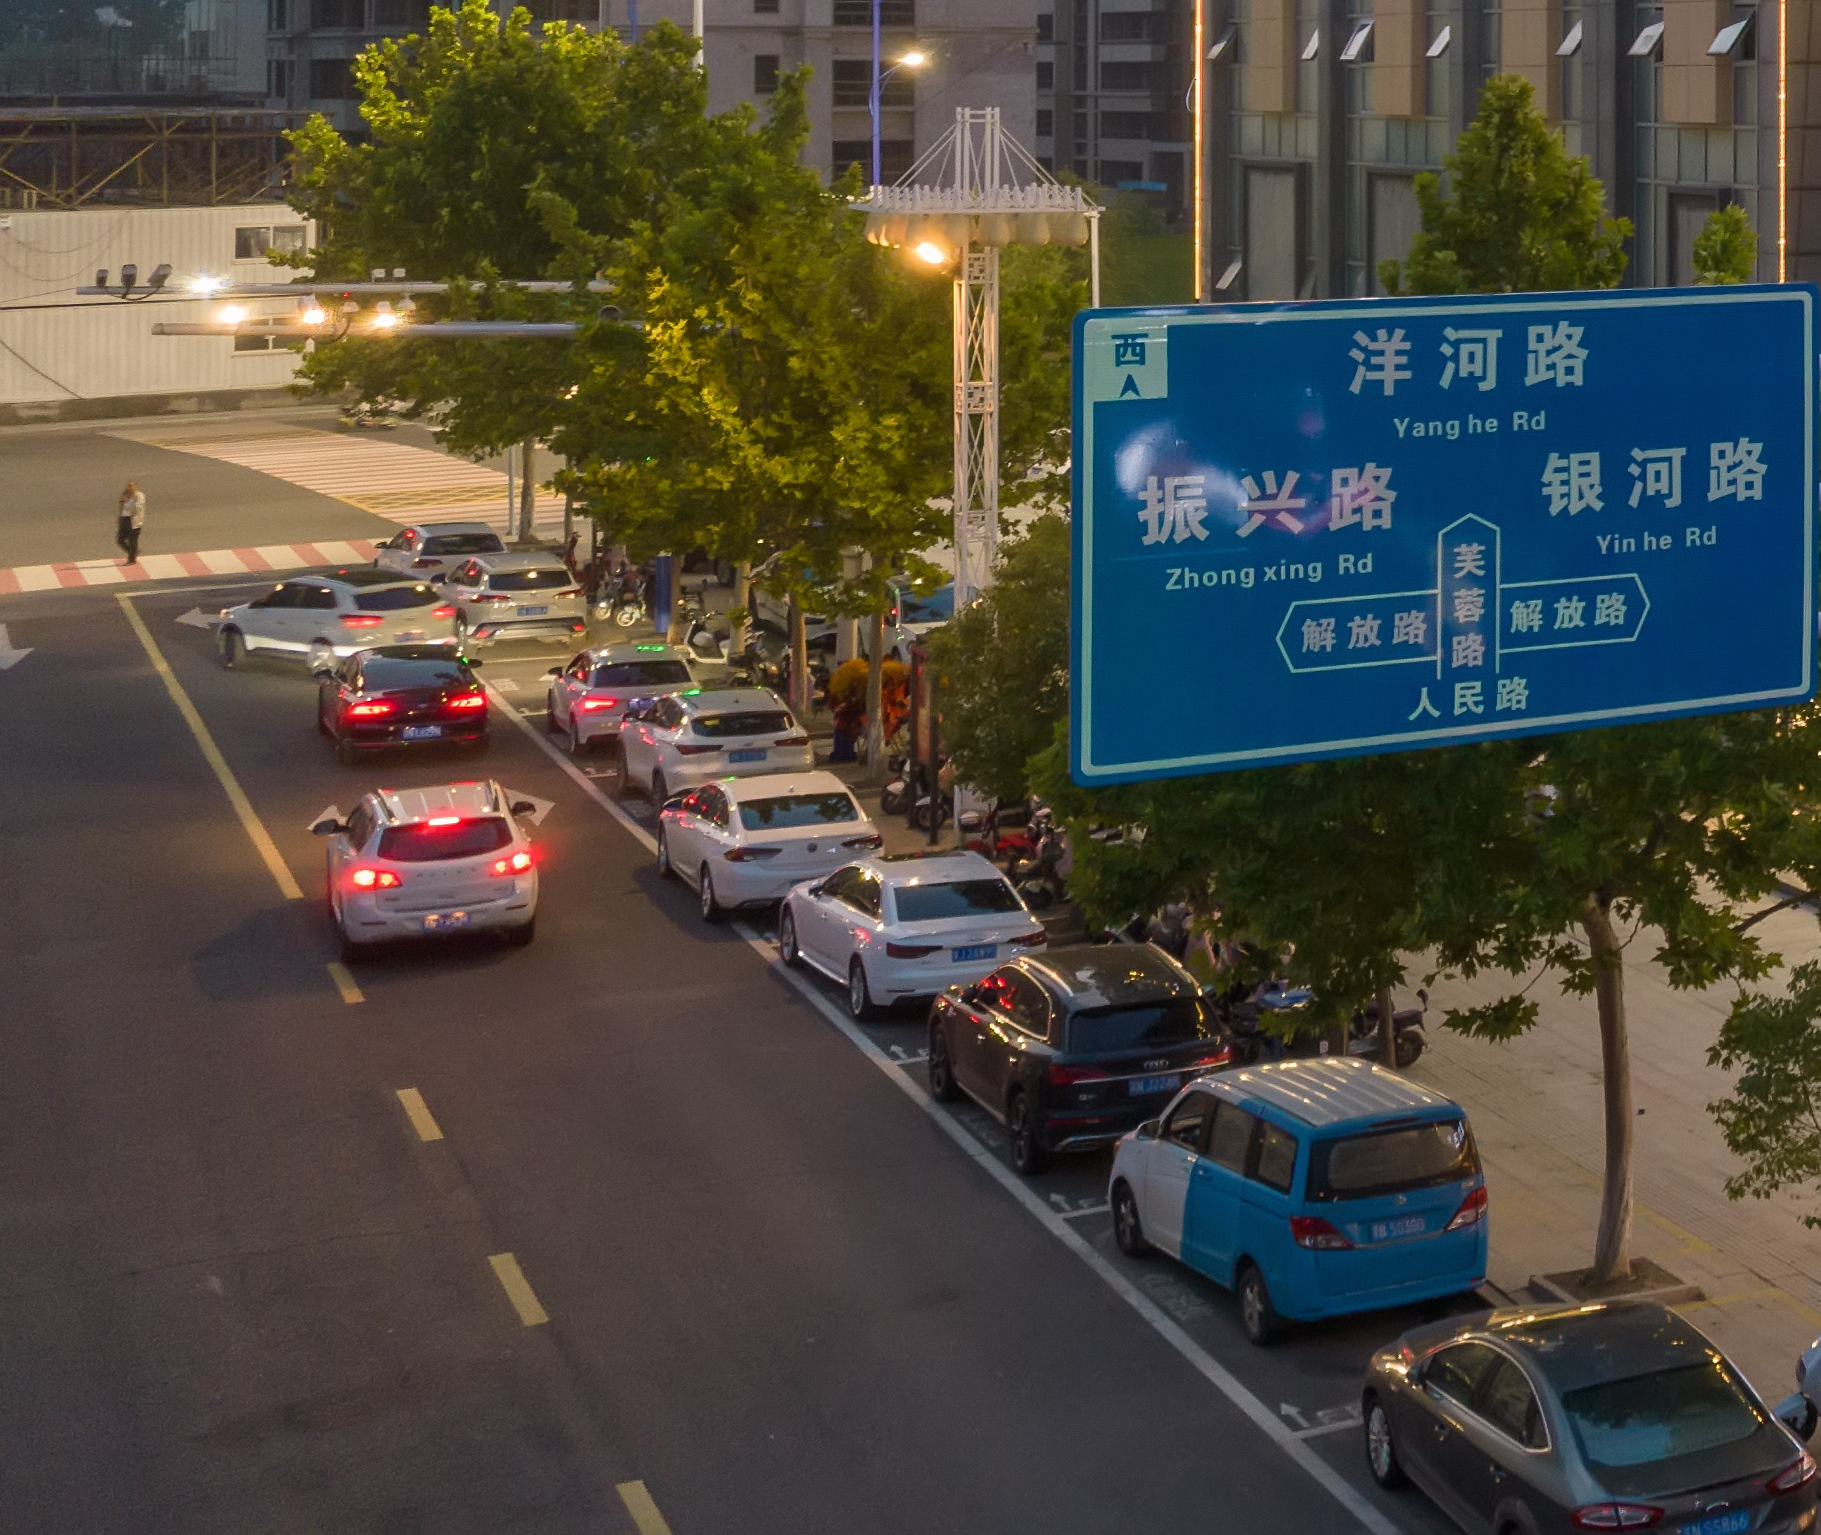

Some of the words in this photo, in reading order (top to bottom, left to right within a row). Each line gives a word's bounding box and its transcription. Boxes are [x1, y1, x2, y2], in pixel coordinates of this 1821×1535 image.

[1112, 331, 1148, 368] 西
[1348, 319, 1590, 397] 洋河路
[1512, 408, 1547, 434] Rd
[1541, 436, 1770, 517] 银河路
[1137, 461, 1398, 547] 振兴路
[1685, 525, 1718, 548] Rd
[1337, 552, 1374, 578] Rd
[1450, 542, 1487, 671] 芙蓉路
[1510, 591, 1629, 635] 解放路
[1300, 608, 1429, 655] 解放路
[1407, 676, 1531, 723] 人民路
